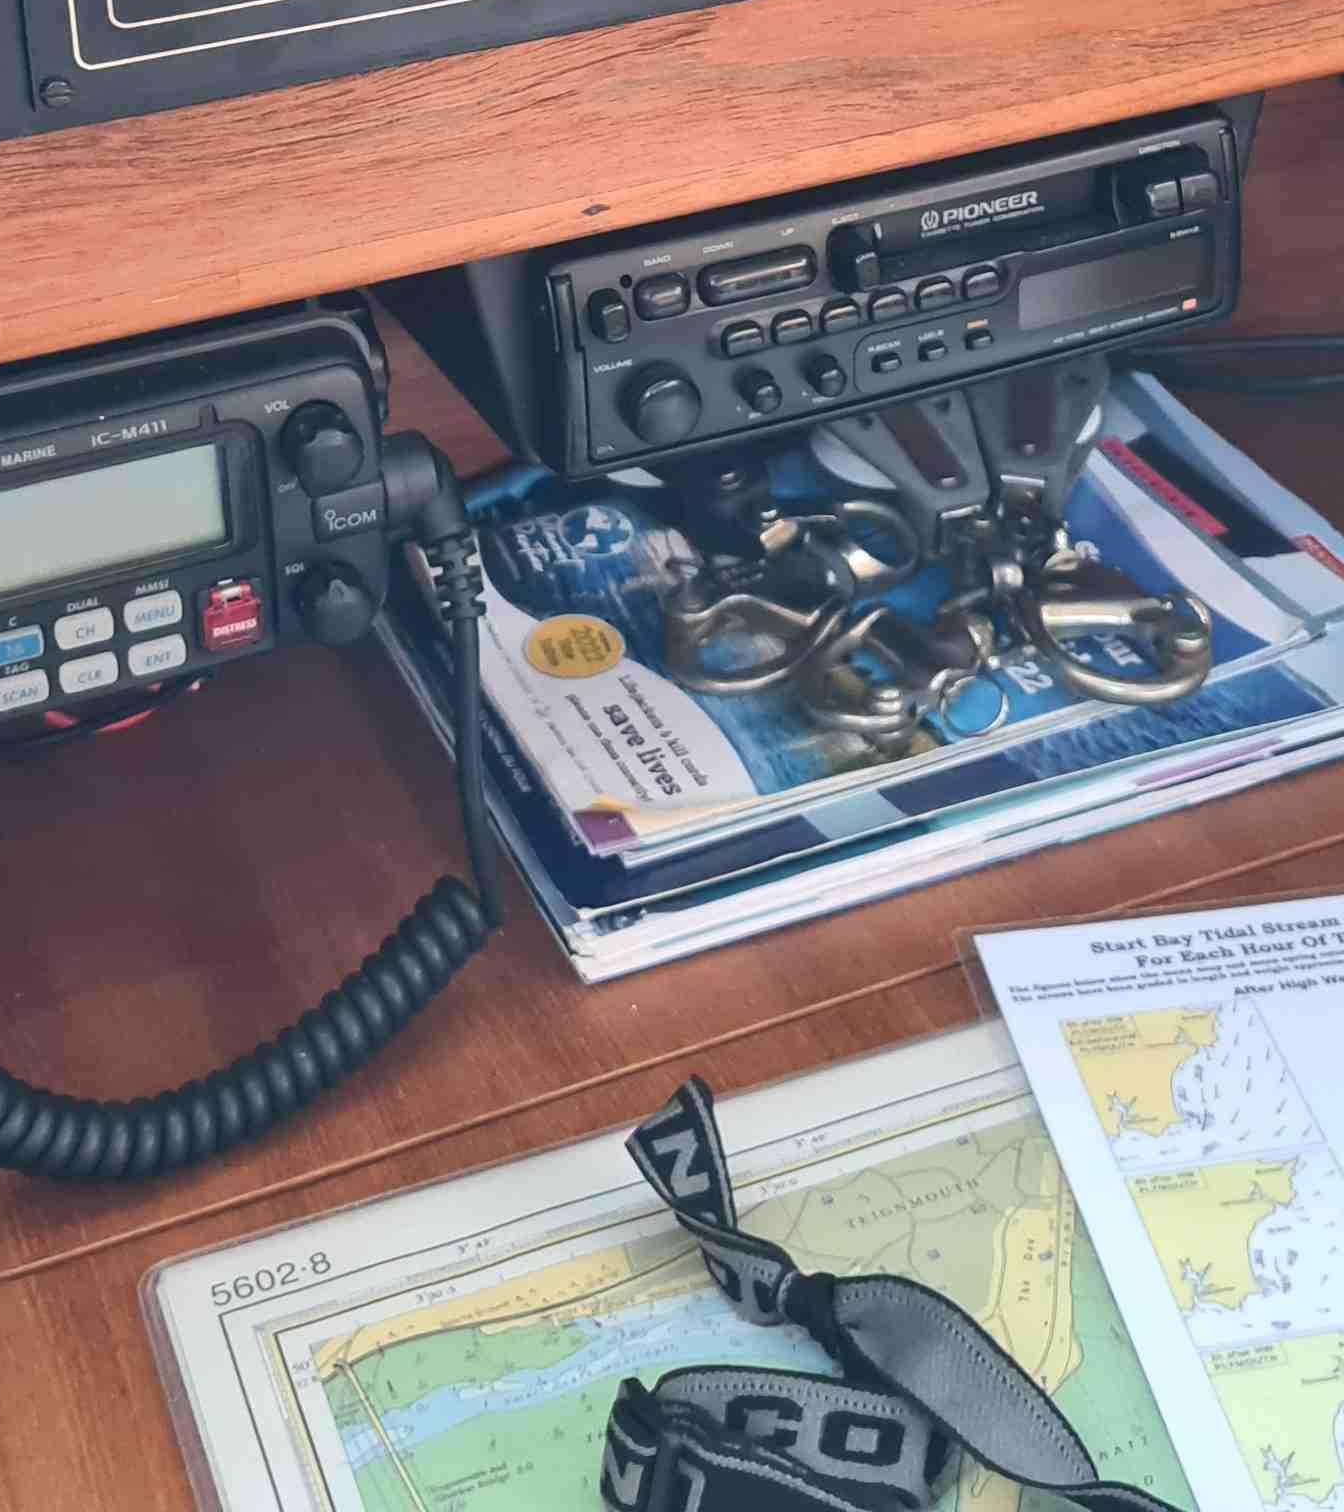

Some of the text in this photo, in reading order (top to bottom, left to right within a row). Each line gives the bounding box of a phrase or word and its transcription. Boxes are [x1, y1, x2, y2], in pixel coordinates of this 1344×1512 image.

[943, 191, 1039, 225] PIONEER
[264, 400, 291, 414] VOL
[91, 420, 168, 448] IC-M411
[1, 444, 57, 468] MARINE
[213, 617, 257, 637] DISTRESS
[603, 702, 682, 797] save lives
[1090, 937, 1146, 954] Start
[1152, 934, 1193, 950] Bay
[1198, 925, 1256, 942] Tidal
[1262, 913, 1341, 935] Stream
[1135, 954, 1172, 968] For
[1180, 945, 1235, 963] Each
[1241, 934, 1295, 955] Hour
[1302, 932, 1329, 948] Of
[1233, 983, 1275, 996] After
[1279, 976, 1319, 990] High
